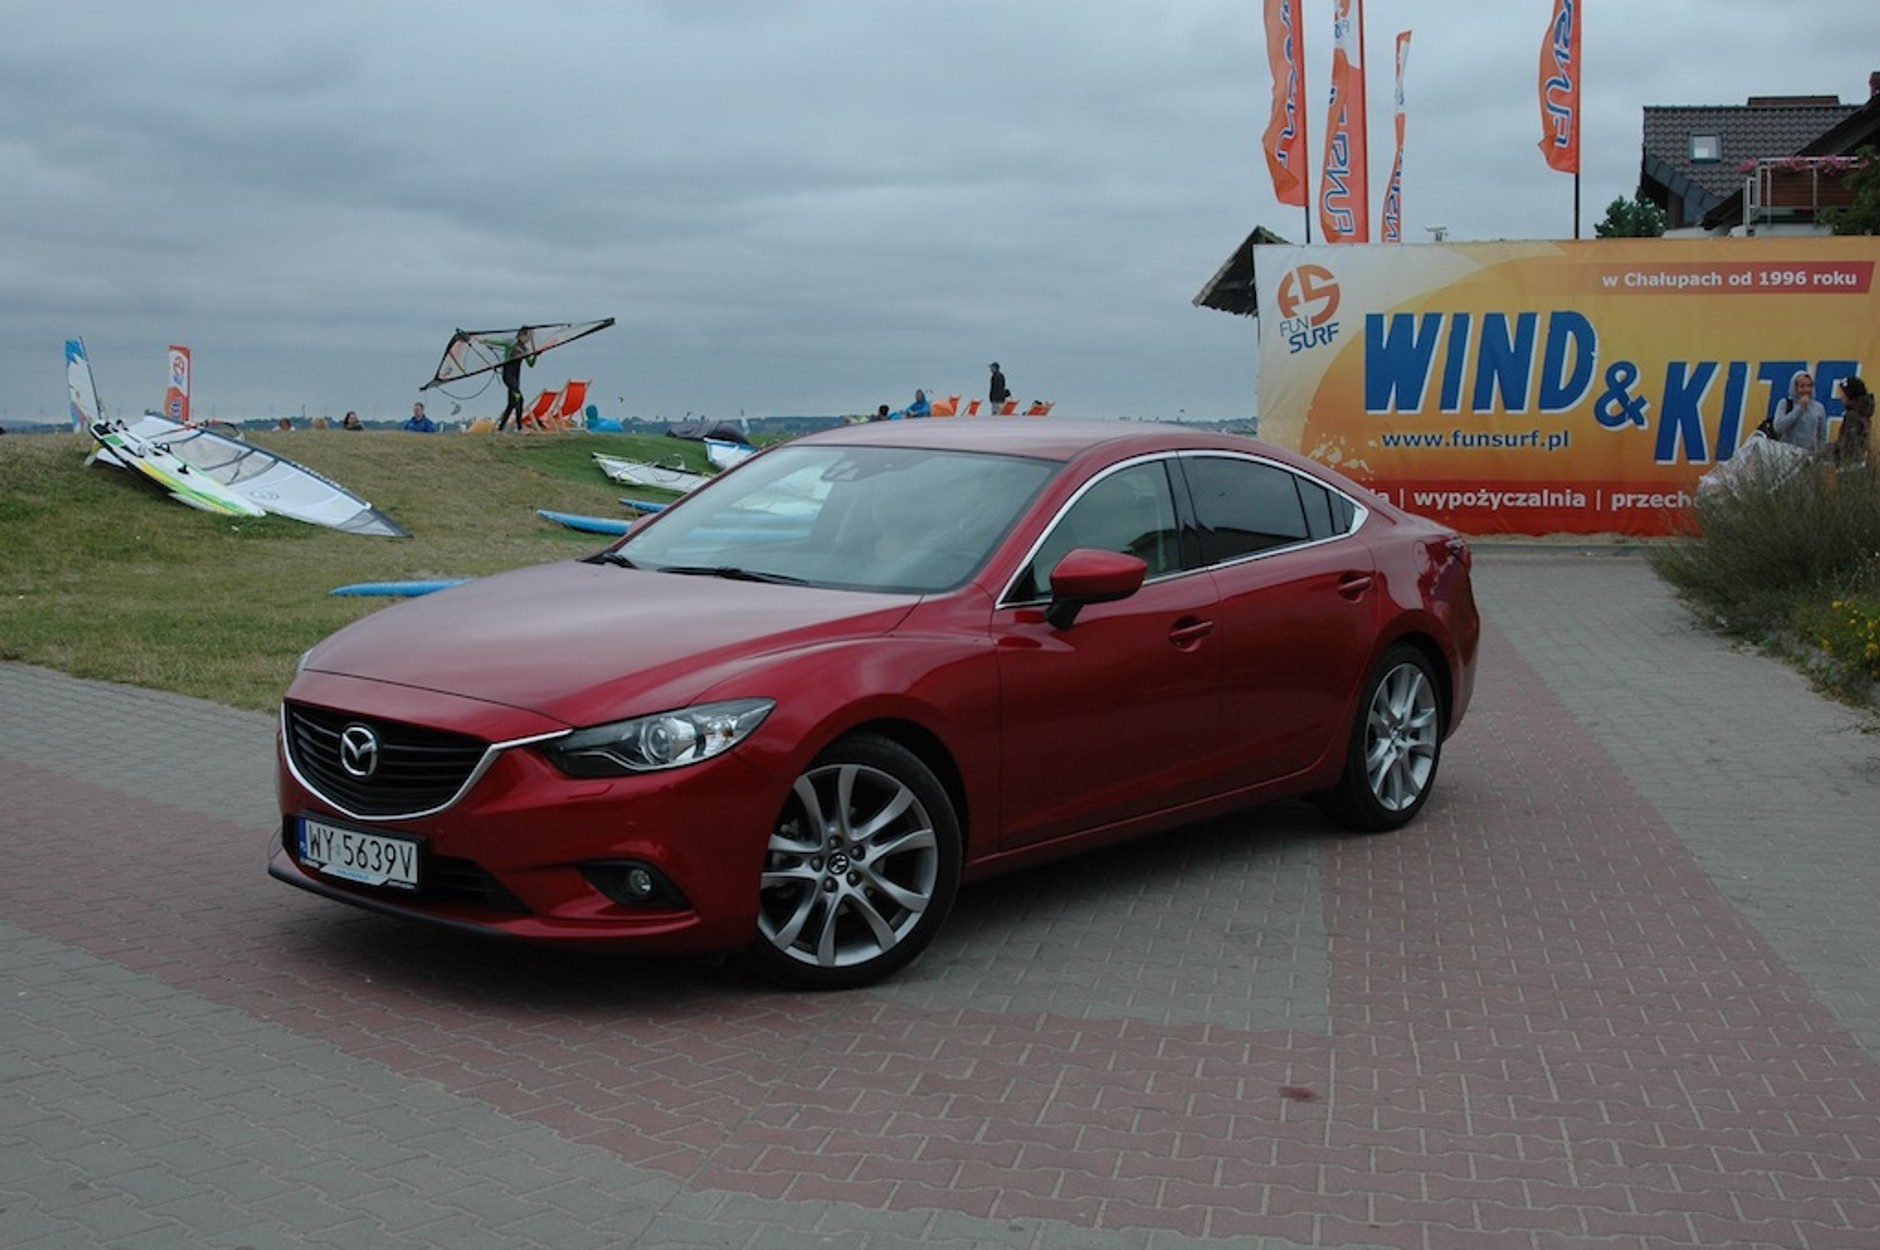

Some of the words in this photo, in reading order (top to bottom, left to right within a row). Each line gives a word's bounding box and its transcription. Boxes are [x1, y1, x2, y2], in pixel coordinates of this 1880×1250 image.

[1602, 274, 1619, 287] w
[1624, 271, 1722, 289] Chałupach
[1728, 271, 1752, 286] od
[1759, 271, 1807, 286] 1996
[1813, 270, 1857, 286] roku
[1280, 315, 1309, 337] FUN
[1289, 322, 1340, 354] SURF
[1365, 311, 1598, 414] WIND
[1594, 361, 1650, 430] &
[1382, 430, 1569, 451] www.funsurf.pl
[1414, 488, 1586, 510] wypożyczalnia
[308, 823, 334, 862] WY
[343, 834, 413, 879] 5639V
